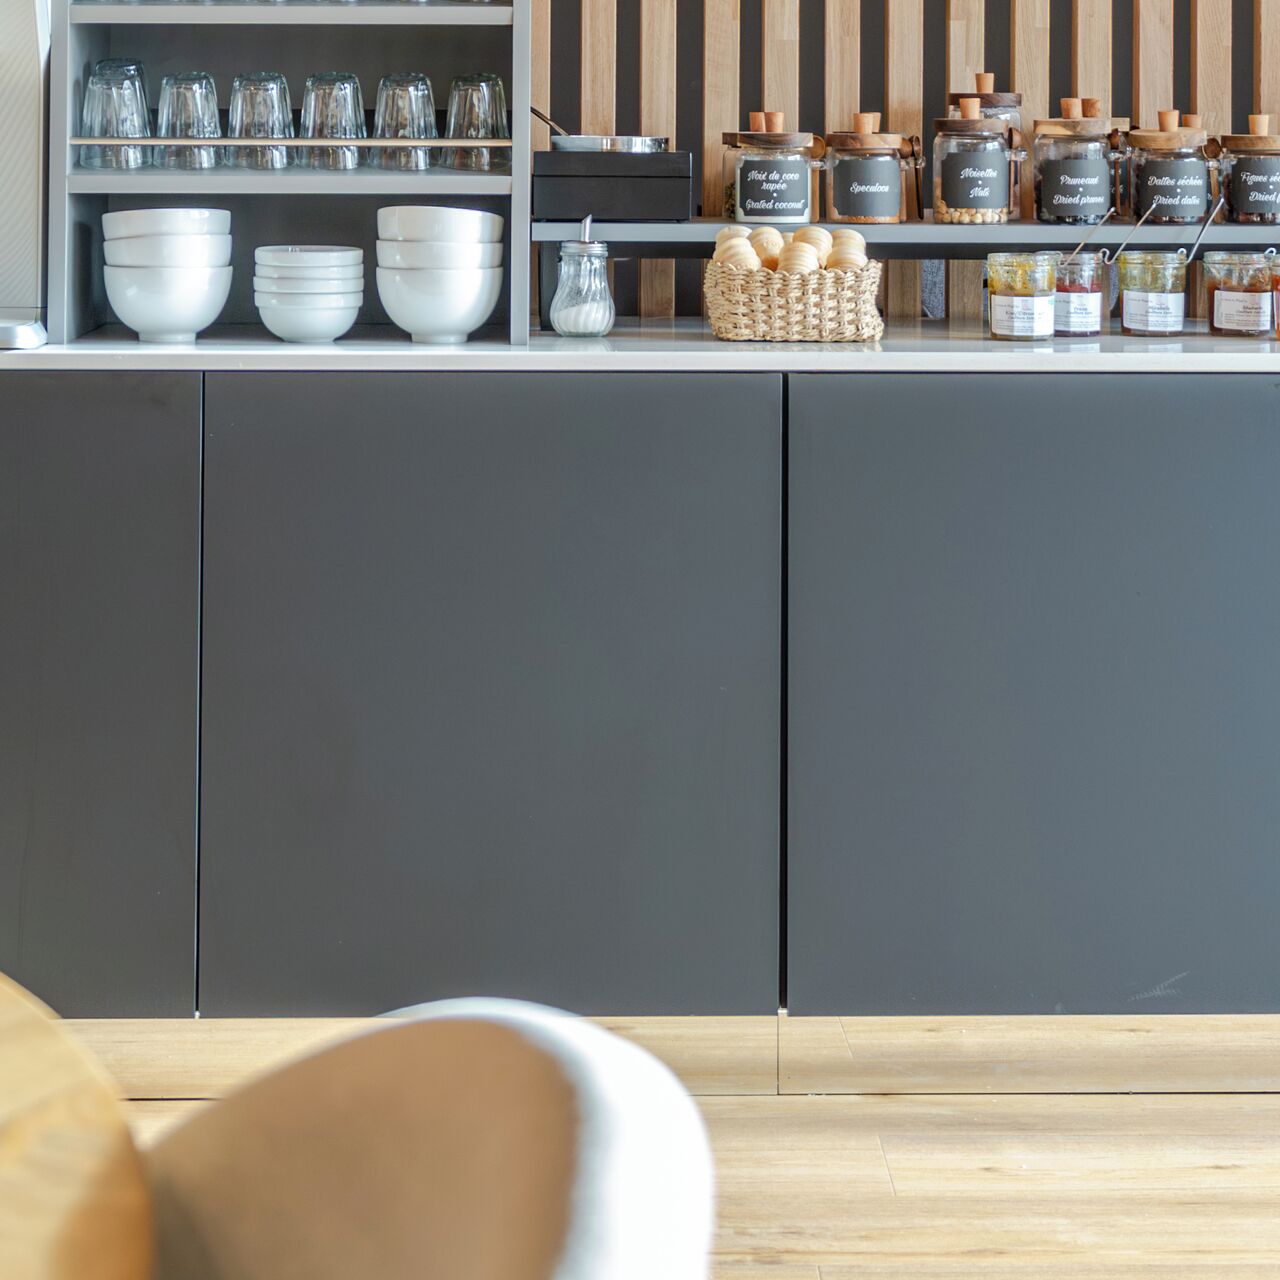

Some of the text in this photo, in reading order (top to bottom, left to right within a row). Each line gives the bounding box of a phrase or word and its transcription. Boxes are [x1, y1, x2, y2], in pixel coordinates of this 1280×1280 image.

[768, 170, 780, 180] de
[781, 172, 800, 180] coco
[1147, 175, 1176, 187] Dattes
[1052, 193, 1081, 205] Dried
[1152, 194, 1181, 206] Dried
[1248, 190, 1277, 202] Dried
[745, 199, 774, 211] Grated
